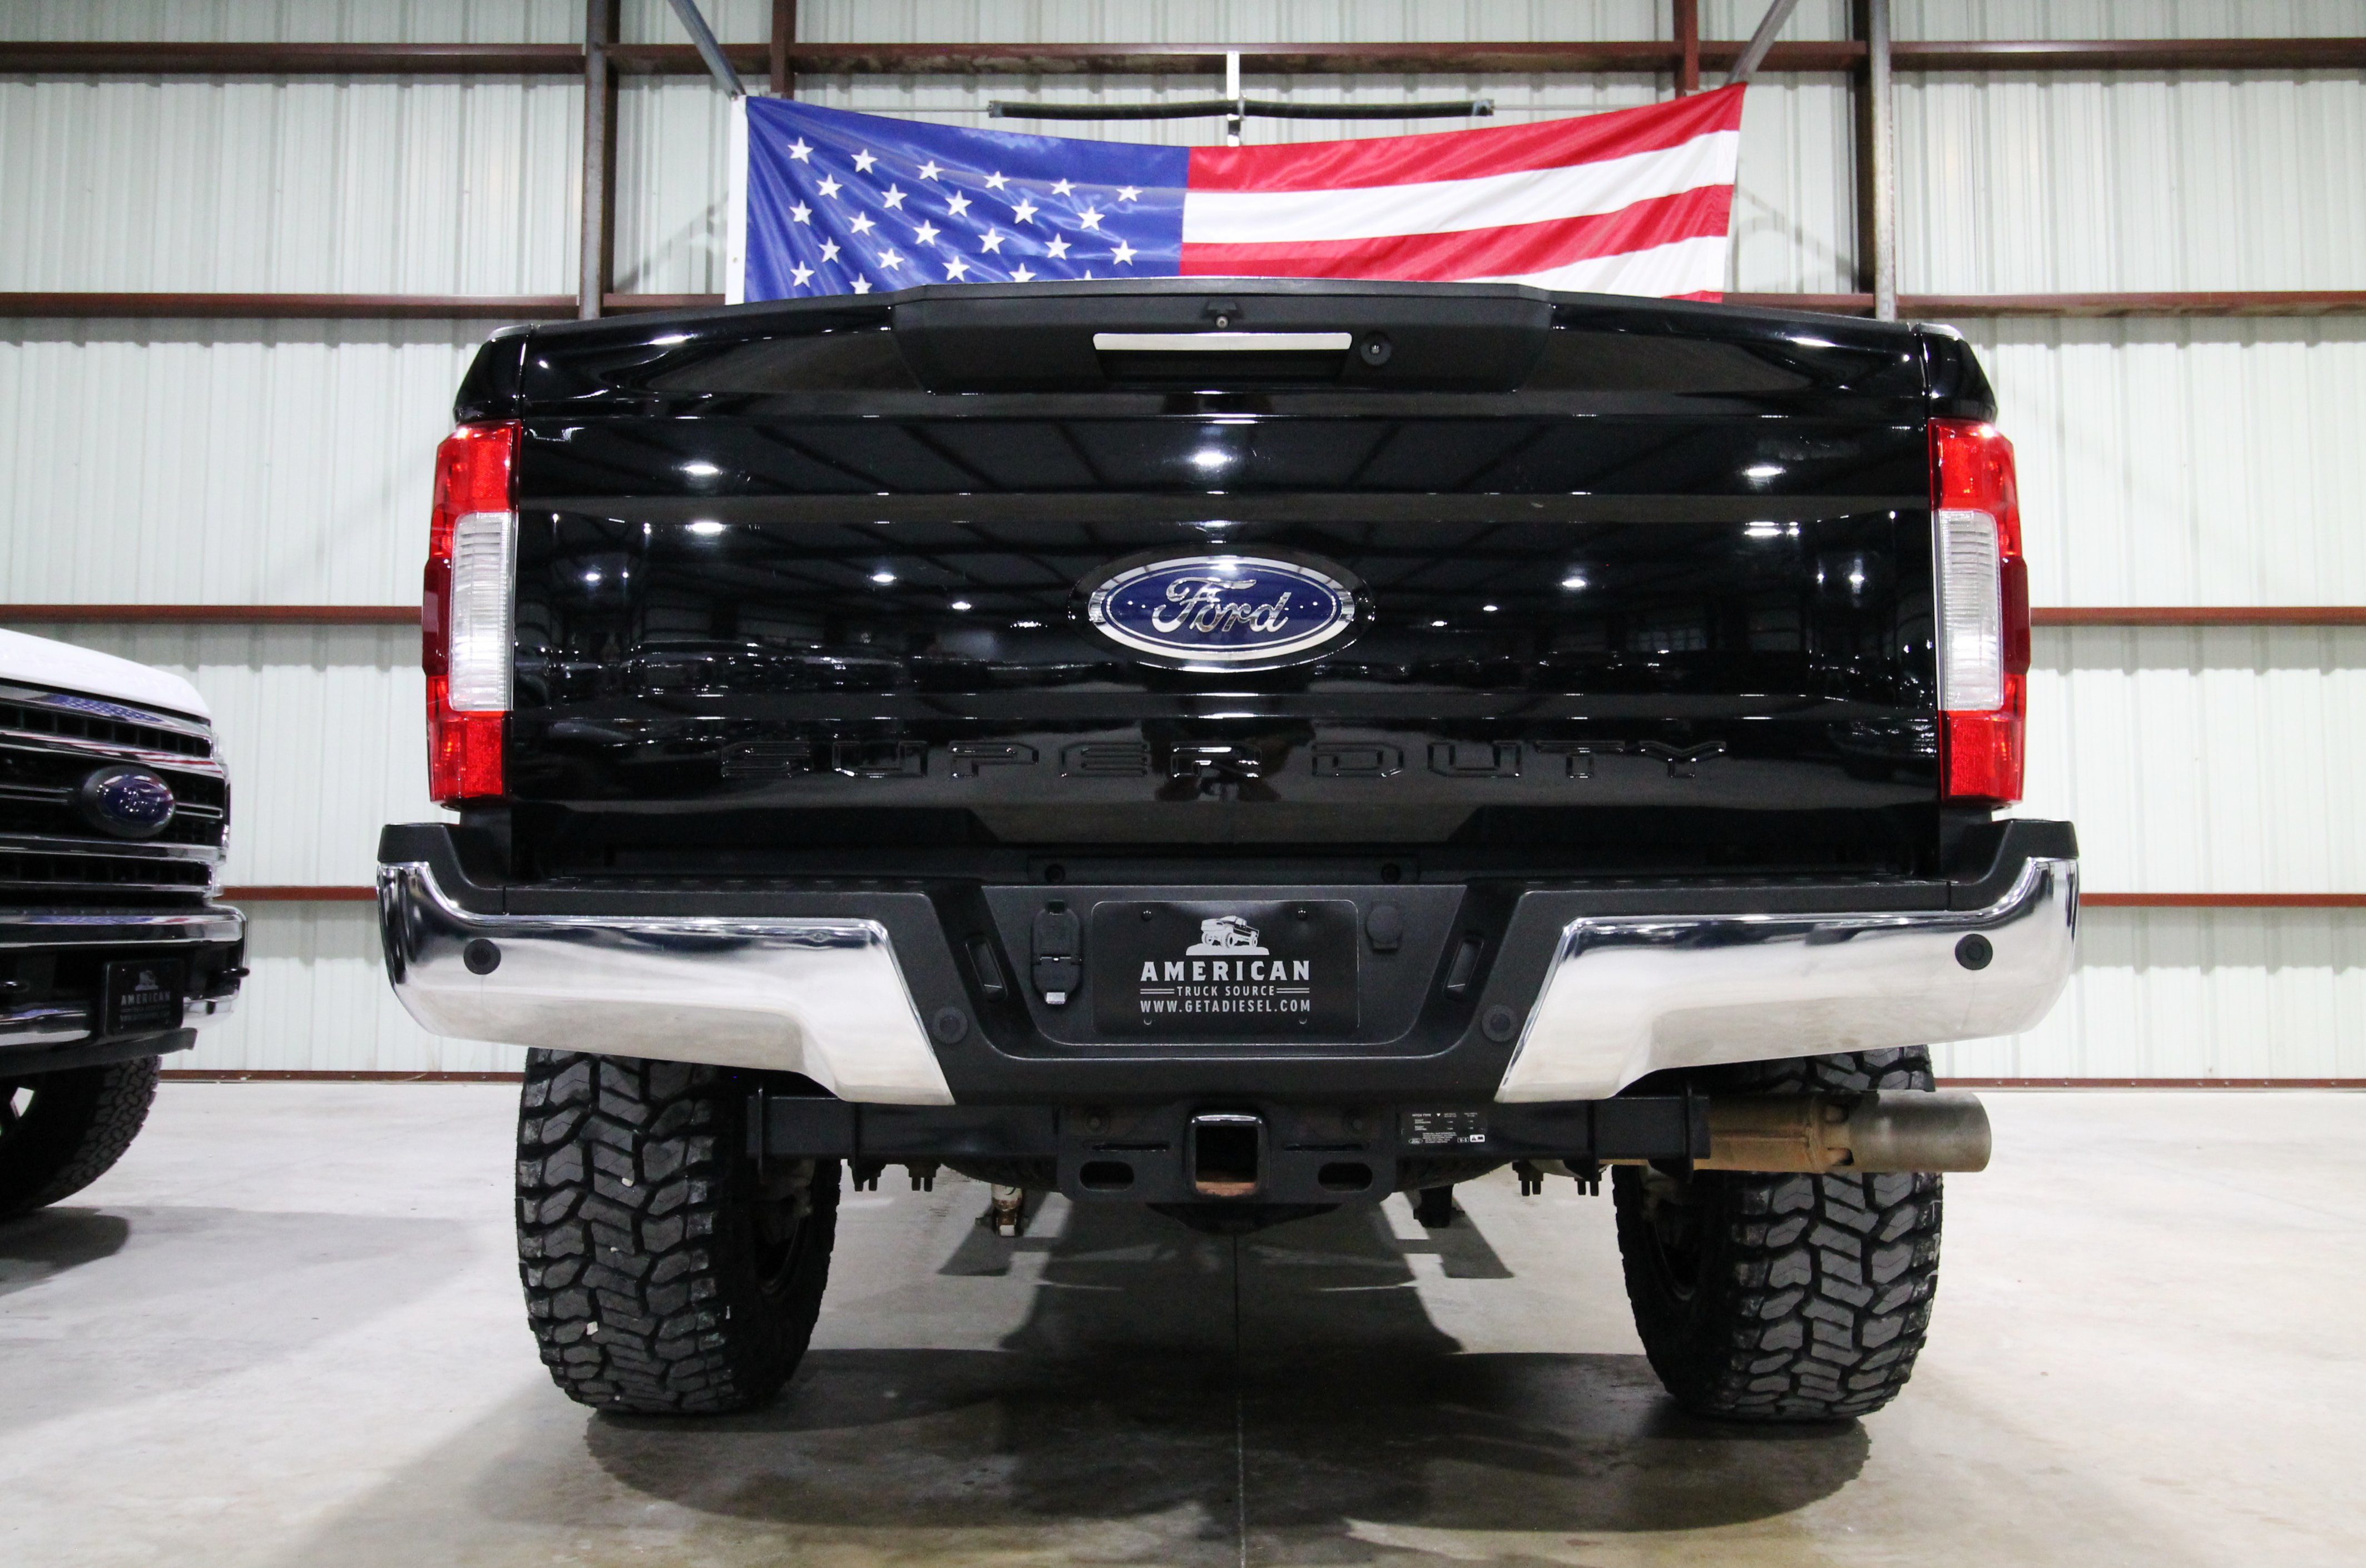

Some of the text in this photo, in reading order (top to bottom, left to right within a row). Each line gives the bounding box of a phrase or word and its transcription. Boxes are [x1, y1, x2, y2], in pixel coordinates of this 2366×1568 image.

[1151, 576, 1289, 633] Ford
[721, 740, 1727, 778] SUPER DUTY
[1140, 960, 1309, 981] AMERICAN
[121, 991, 170, 1006] AMERICAN
[1176, 985, 1275, 996] TRUCK SOURCE
[1140, 1000, 1310, 1013] WWW.GETADIESEL.COM
